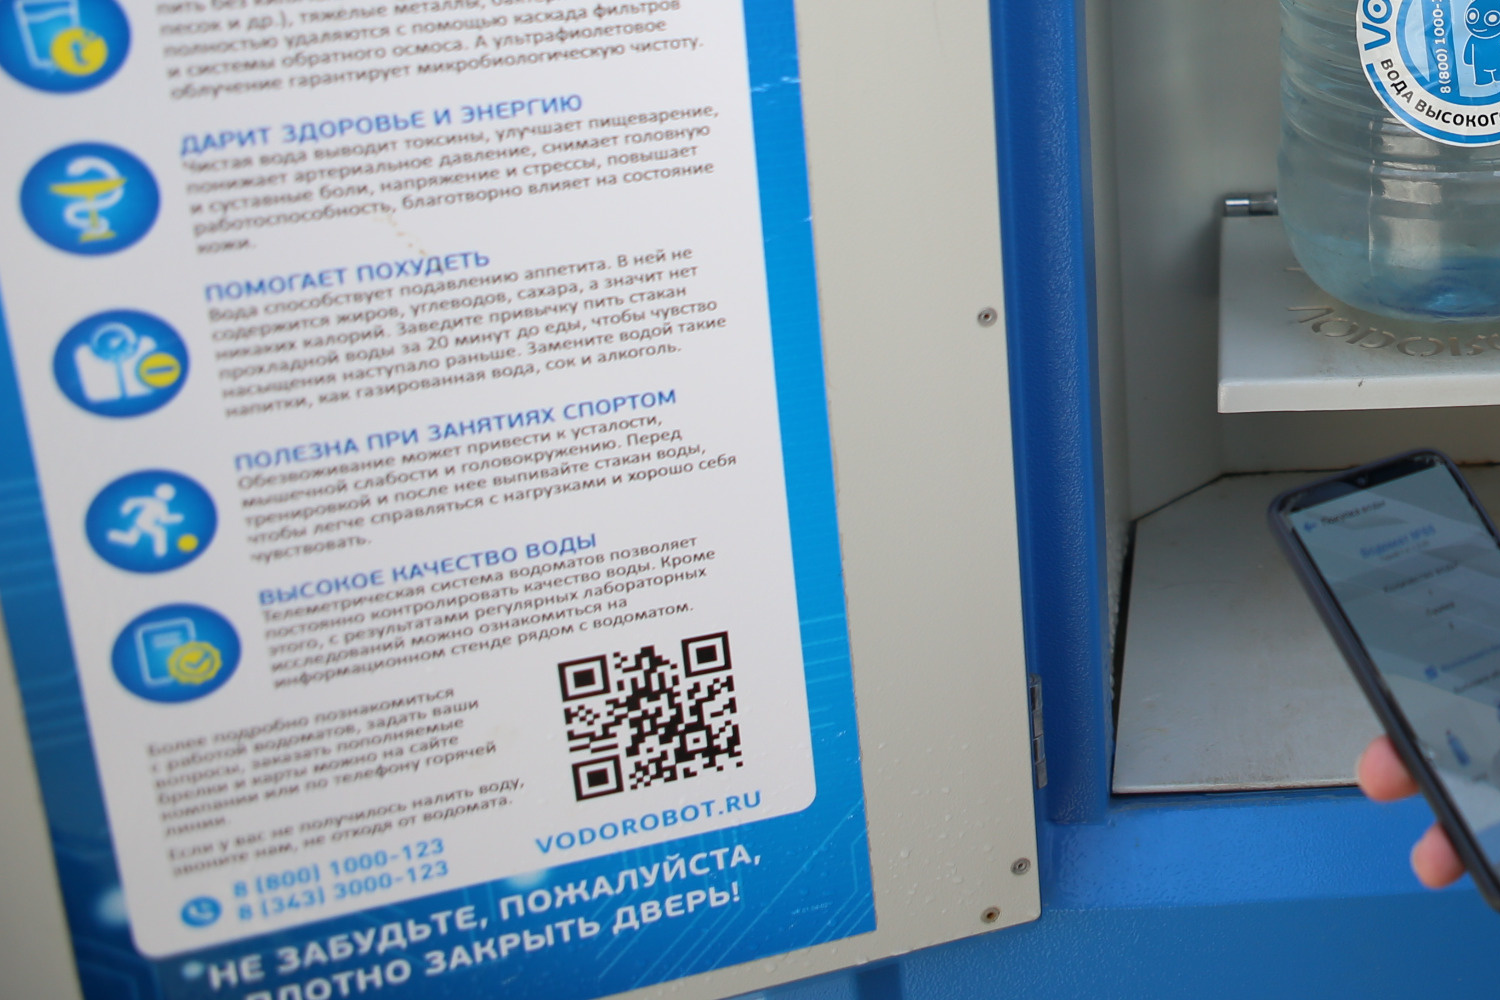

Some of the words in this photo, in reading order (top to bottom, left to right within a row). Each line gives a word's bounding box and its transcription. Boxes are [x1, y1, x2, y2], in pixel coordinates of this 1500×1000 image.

[1380, 58, 1416, 104] ВОДА
[179, 126, 271, 156] ДАРИТ
[282, 110, 424, 142] ЗДОРОВЬЕ
[432, 108, 451, 125] И
[460, 94, 582, 122] ЭНЕРГИЮ
[540, 135, 620, 154] снимает
[622, 125, 711, 145] головную
[505, 167, 517, 178] и
[595, 175, 617, 187] на
[622, 163, 714, 184] состояние
[205, 268, 348, 302] ПОМОГАЕТ
[354, 250, 490, 282] ПОХУДЕТЬ
[516, 282, 584, 300] сахара,
[588, 279, 599, 290] а
[604, 270, 664, 288] значит
[668, 266, 698, 279] нет
[523, 259, 610, 280] аппетита.
[616, 254, 628, 267] В
[633, 248, 666, 265] ней
[671, 248, 692, 260] не
[425, 335, 449, 351] 20
[453, 329, 511, 347] минут
[514, 325, 540, 340] до
[543, 319, 587, 334] еды,
[590, 309, 645, 327] чтобы
[649, 300, 717, 321] чувство
[487, 301, 579, 325] привычку
[582, 294, 625, 310] пить
[628, 286, 687, 303] стакан
[527, 333, 614, 355] Замените
[618, 321, 673, 342] водой
[677, 317, 726, 333] такие
[490, 363, 540, 379] вода,
[544, 357, 576, 371] сок
[580, 355, 592, 366] и
[596, 342, 681, 363] алкоголь.
[235, 437, 359, 472] ПОЛЕЗНА
[365, 428, 419, 451] ПРИ
[426, 407, 555, 441] ЗАНЯТИЯХ
[561, 388, 676, 420] СПОРТОМ
[444, 465, 455, 476] и
[461, 439, 620, 473] головокружению.
[626, 429, 682, 446] Перед
[465, 431, 551, 456] привести
[555, 429, 566, 440] к
[569, 415, 662, 441] усталости,
[376, 494, 389, 506] и
[453, 478, 487, 493] нее
[491, 461, 589, 486] выпивайте
[593, 451, 651, 470] стакан
[655, 443, 705, 460] воды,
[488, 495, 498, 505] с
[502, 477, 606, 503] нагрузками
[610, 474, 622, 485] и
[627, 462, 694, 482] хорошо
[697, 453, 736, 470] себя
[258, 569, 384, 606] ВЫСОКОЕ
[389, 546, 519, 582] КАЧЕСТВО
[523, 532, 597, 559] ВОДЫ
[369, 585, 519, 621] контролировать
[523, 570, 601, 593] качество
[605, 561, 655, 578] воды.
[659, 549, 715, 569] Кроме
[429, 571, 504, 593] система
[508, 553, 605, 579] водоматов
[608, 537, 698, 561] позволяет
[473, 591, 579, 622] регулярных
[580, 567, 708, 599] лабораторных
[409, 626, 474, 647] можно
[477, 602, 602, 634] ознакомиться
[606, 598, 627, 610] на
[449, 635, 512, 656] стенде
[515, 623, 575, 646] рядом
[577, 621, 588, 631] с
[590, 602, 693, 629] водоматом.
[430, 699, 479, 717] ваши
[477, 778, 525, 795] воду,
[533, 789, 762, 855] VODOROBOT.RU
[328, 837, 445, 877] 1000-123
[333, 860, 449, 900] 3000-123
[208, 953, 265, 991] НЕ
[276, 901, 490, 974] ЗАБУДЬТЕ,
[499, 846, 762, 922] ПОЖАЛУЙСТА,
[424, 916, 602, 976] ЗАКРЫТЬ
[611, 880, 741, 936] ДВЕРЬ!
